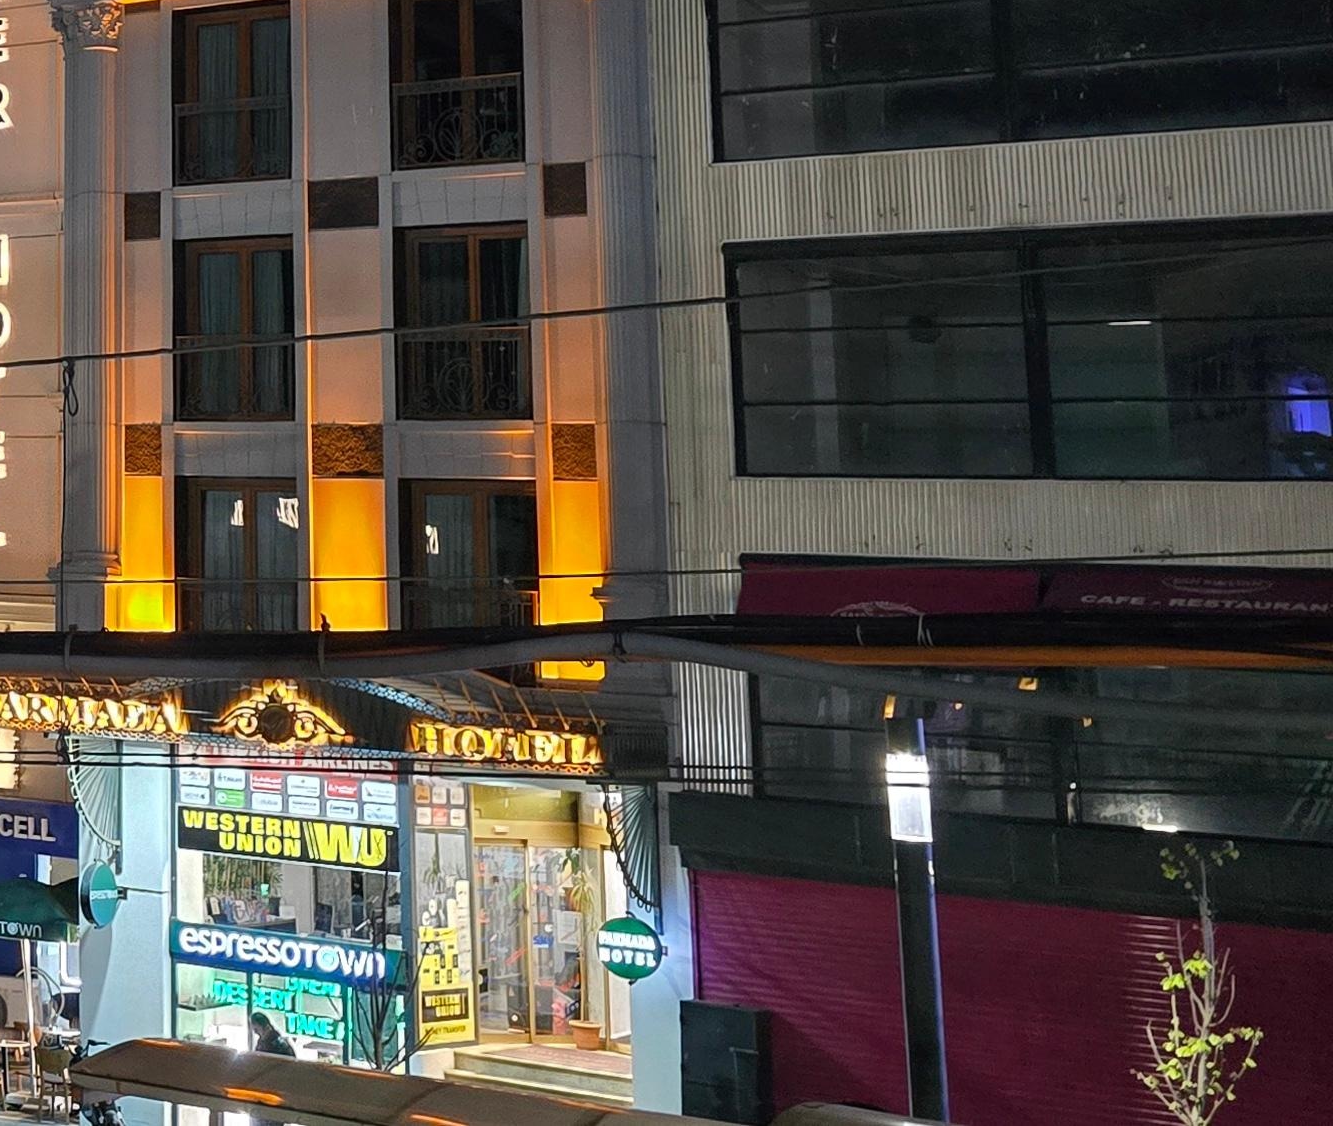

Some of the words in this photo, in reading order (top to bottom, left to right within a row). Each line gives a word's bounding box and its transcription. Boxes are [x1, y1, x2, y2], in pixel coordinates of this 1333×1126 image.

[1080, 594, 1146, 606] CAFE
[411, 722, 603, 764] HOTEL
[182, 809, 301, 838] WESTERN
[218, 830, 302, 858] UNION
[312, 821, 387, 866] WU
[598, 930, 657, 951] PARMADA
[599, 947, 657, 967] HOTEL
[212, 978, 297, 1011] DESSERT
[285, 1012, 334, 1039] TAKE
